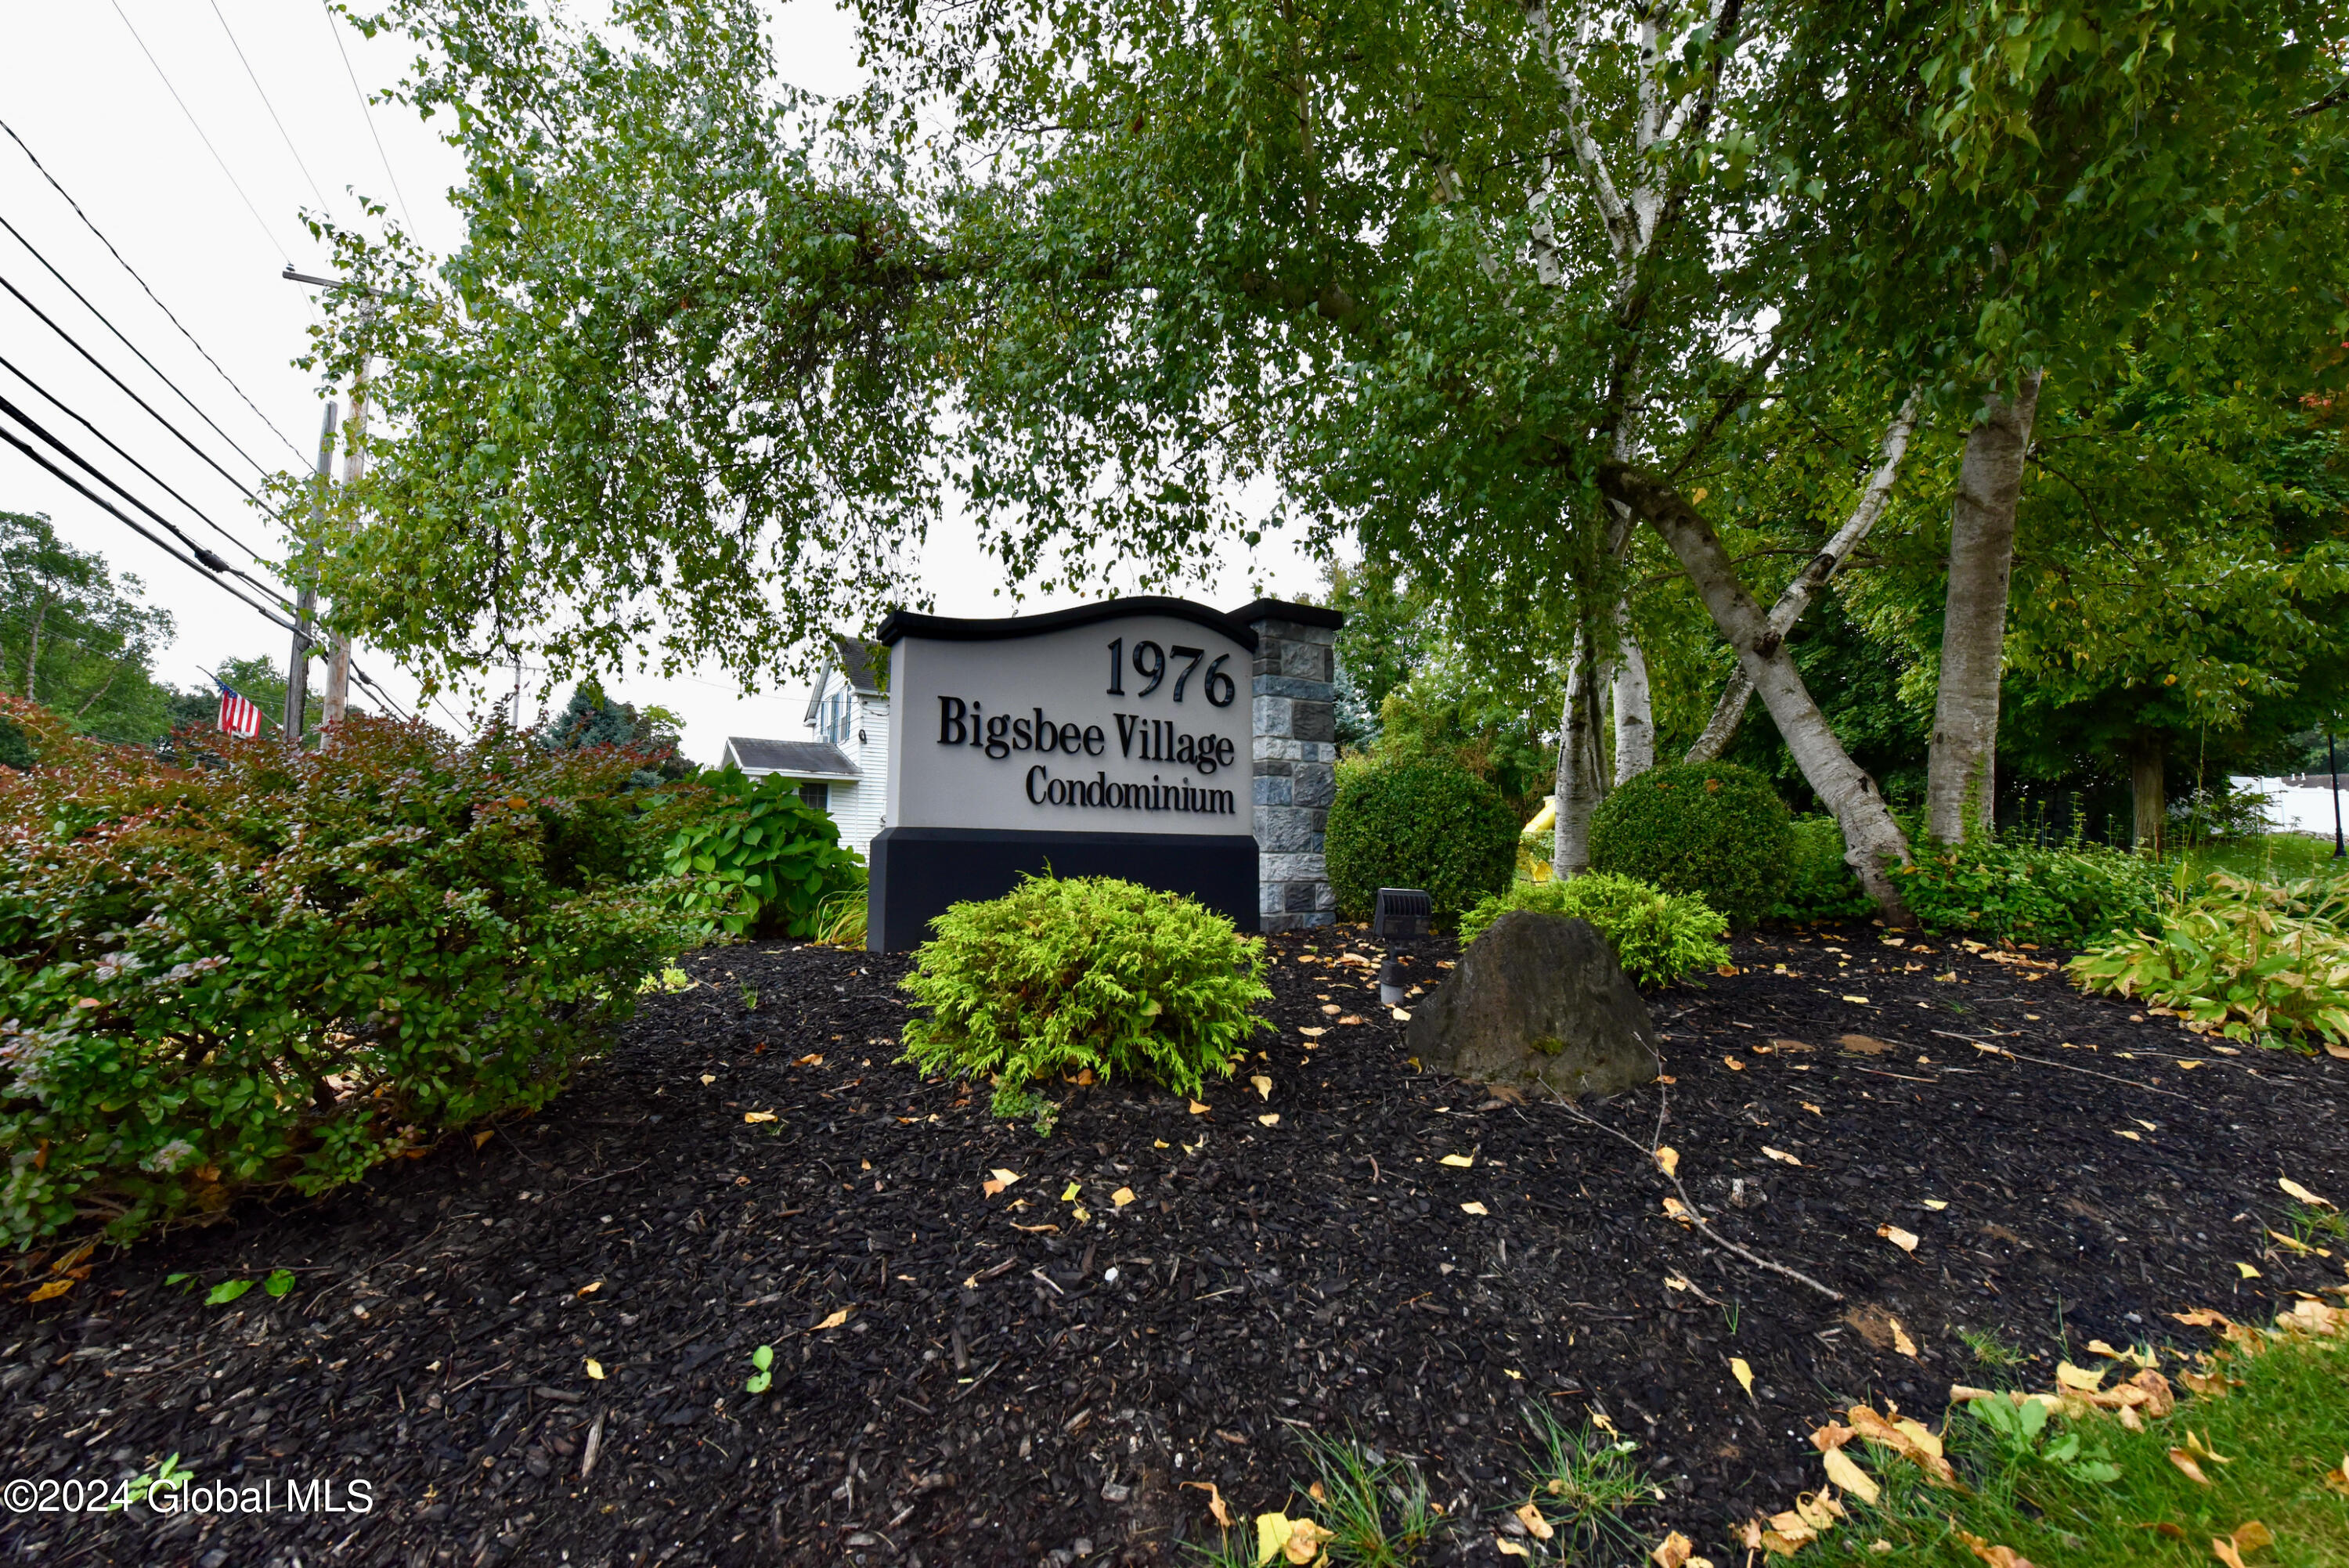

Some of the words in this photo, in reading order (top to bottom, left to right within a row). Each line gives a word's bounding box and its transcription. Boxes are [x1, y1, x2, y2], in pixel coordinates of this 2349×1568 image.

[1106, 637, 1236, 707] 1976
[937, 695, 1105, 759] Bigsbee
[1113, 713, 1235, 774] Village
[1026, 765, 1235, 814] Condominium
